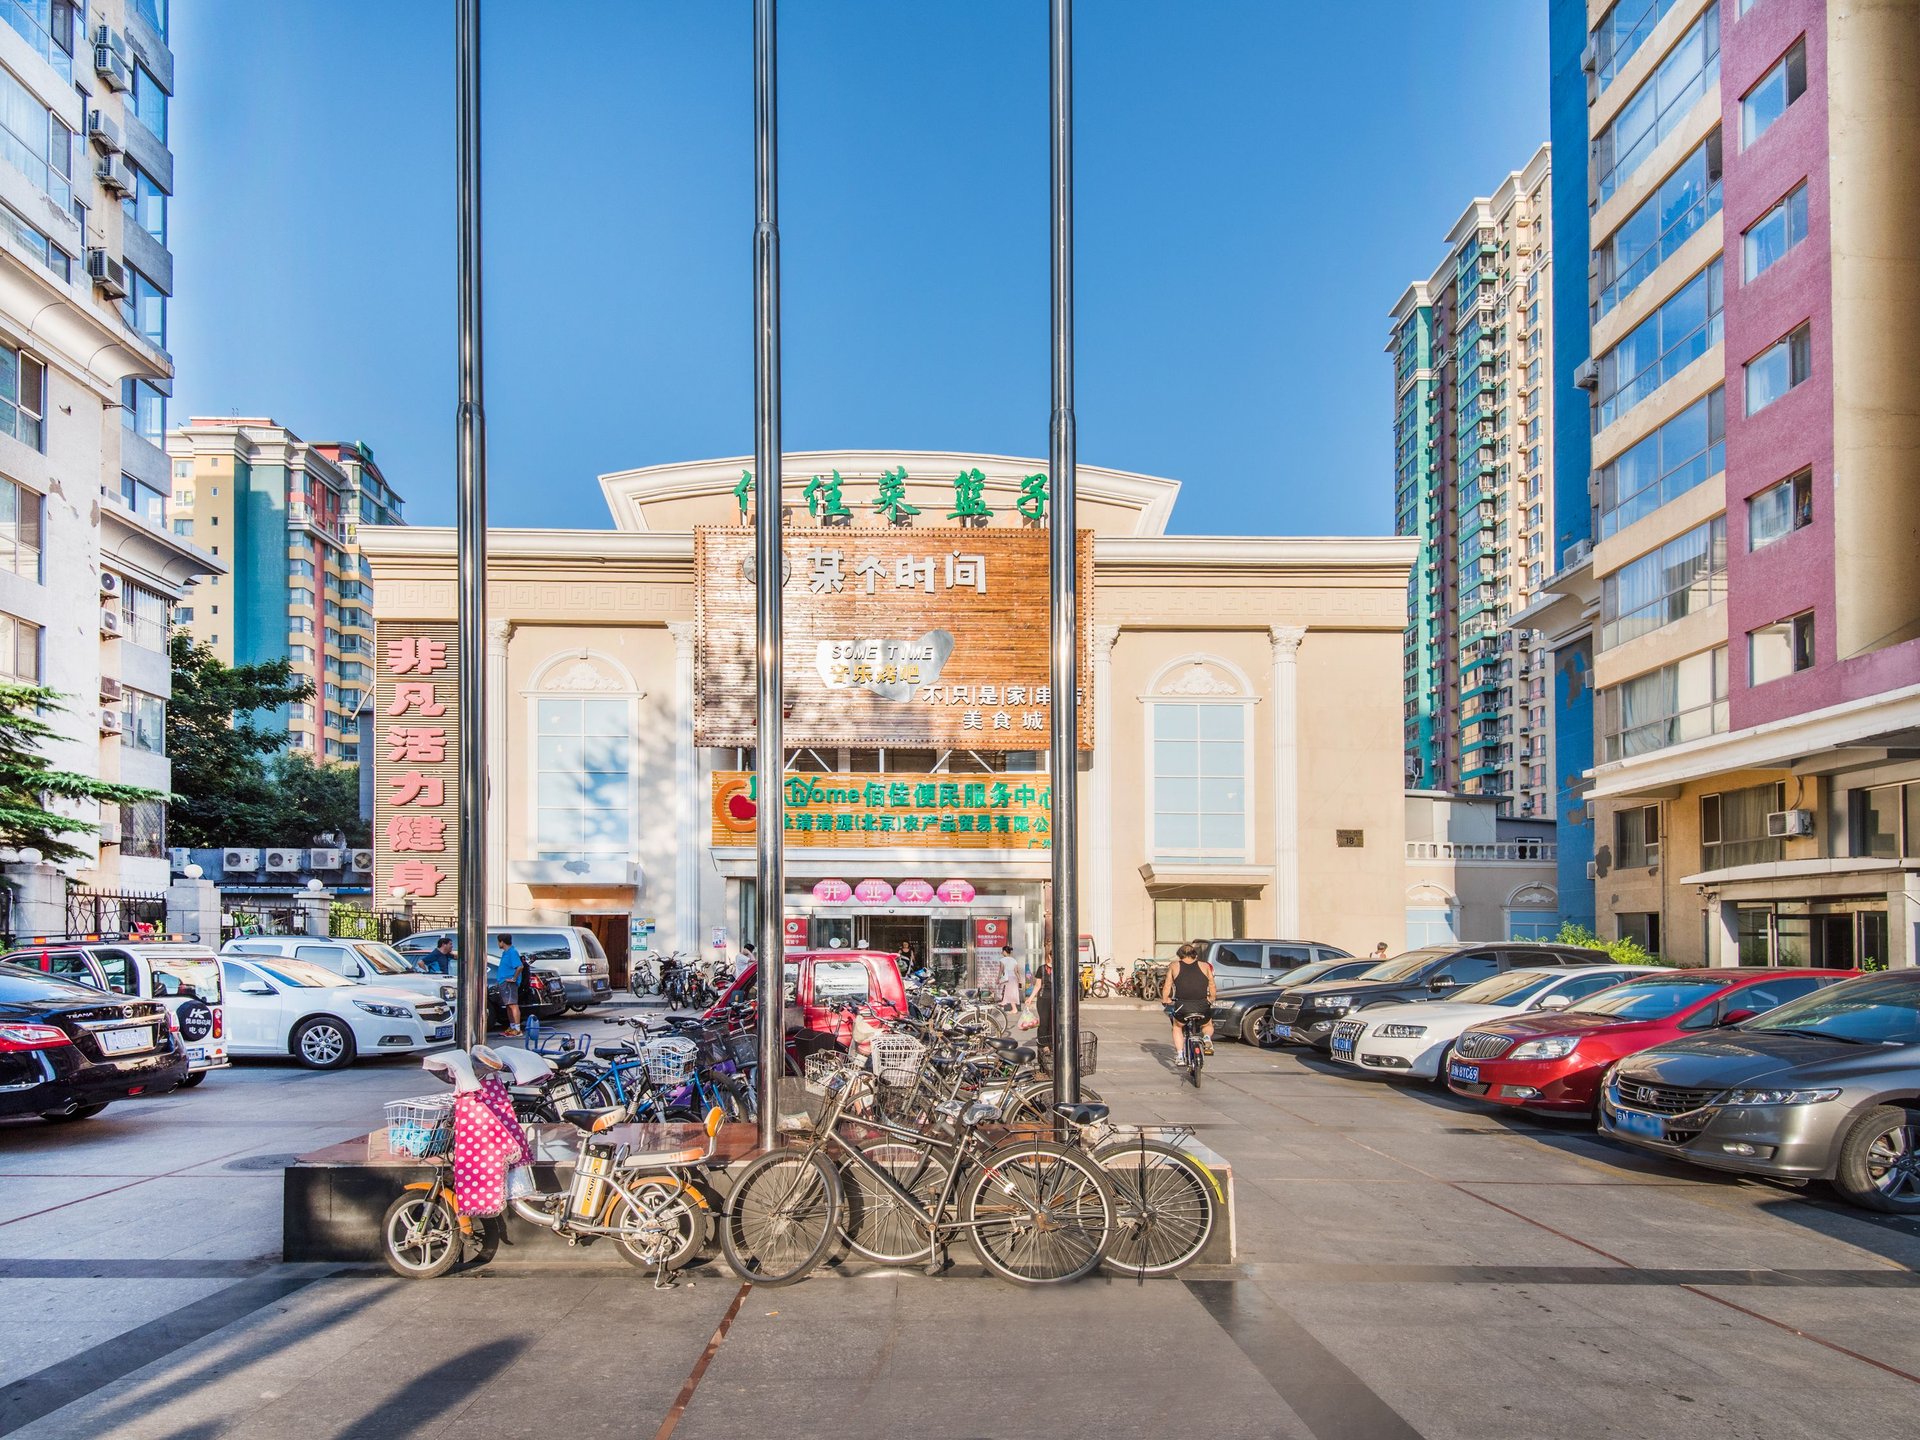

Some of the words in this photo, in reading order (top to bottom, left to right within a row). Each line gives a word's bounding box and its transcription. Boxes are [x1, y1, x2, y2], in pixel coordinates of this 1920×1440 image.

[807, 547, 986, 594] 某个时间
[832, 645, 878, 660] SOME
[888, 645, 934, 660] TIME
[831, 664, 921, 684] 音乐烤吧
[963, 711, 1044, 730] 美食城
[386, 637, 447, 897] 非凡活力健身
[824, 885, 963, 900] 开业大吉
[66, 1011, 94, 1019] TEANA
